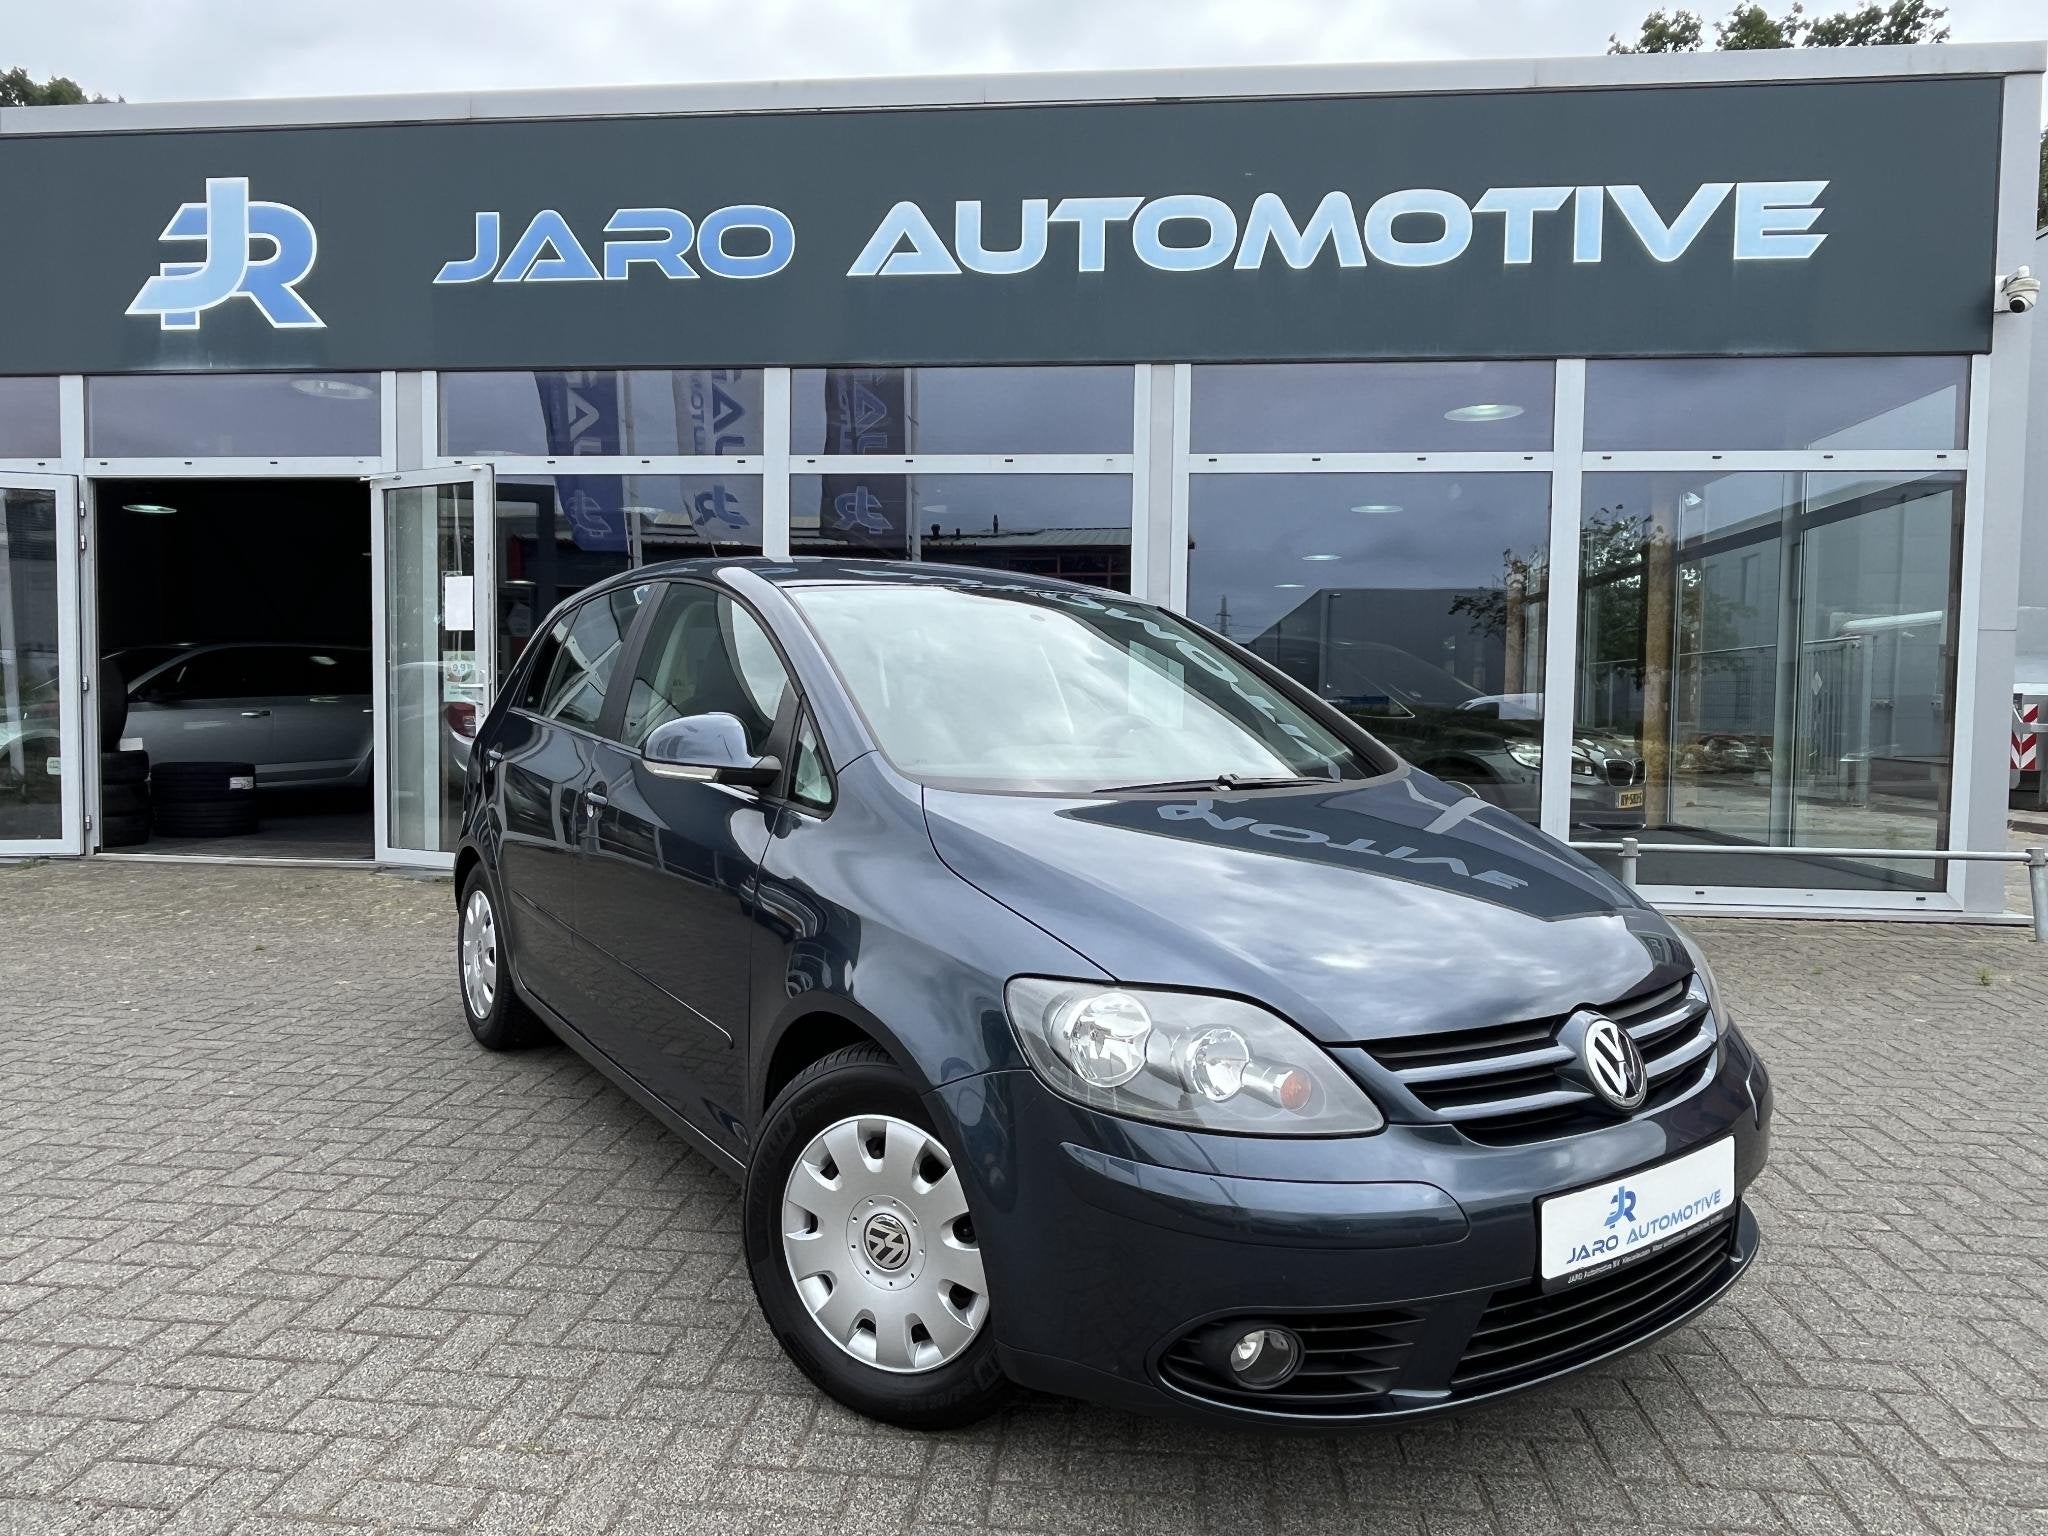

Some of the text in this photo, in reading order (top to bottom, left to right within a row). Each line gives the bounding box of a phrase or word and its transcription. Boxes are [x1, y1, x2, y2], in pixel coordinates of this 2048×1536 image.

[432, 180, 1831, 285] JARO AUTOMOTIVE
[1566, 1234, 1619, 1265] JARO
[1626, 1189, 1722, 1245] AUTOMOTIVE
